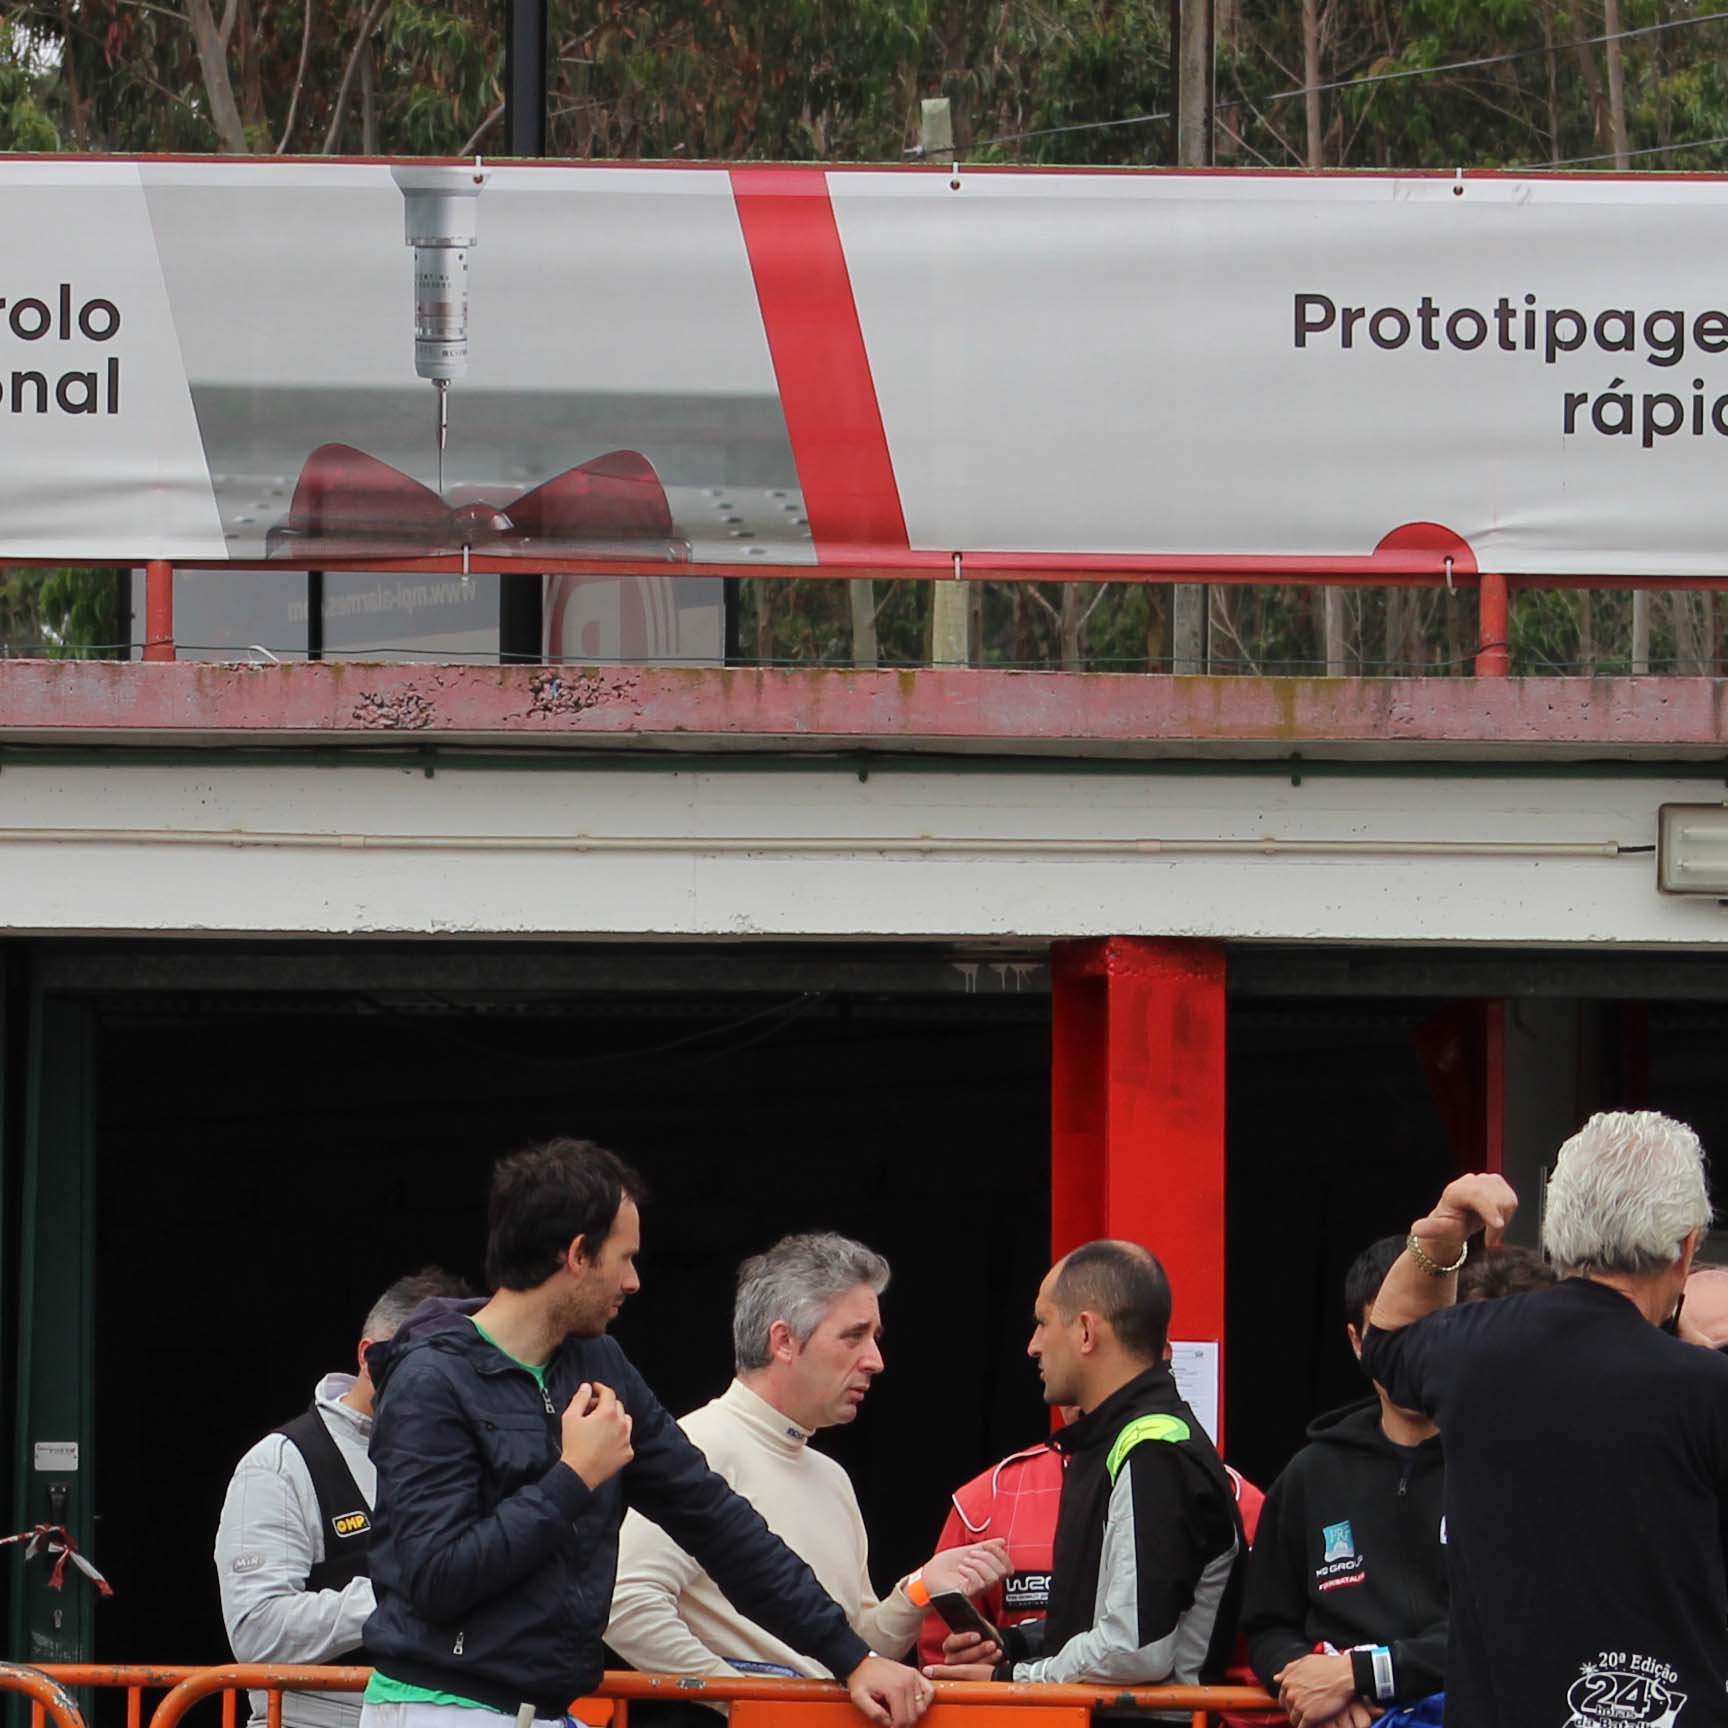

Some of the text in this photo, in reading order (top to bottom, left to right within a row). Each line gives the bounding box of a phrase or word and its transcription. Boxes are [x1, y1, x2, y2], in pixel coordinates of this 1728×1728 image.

[1630, 1654, 1678, 1684] Edição
[1581, 1673, 1651, 1719] 24
[1574, 1717, 1594, 1728] da
[1596, 1704, 1637, 1719] horas
